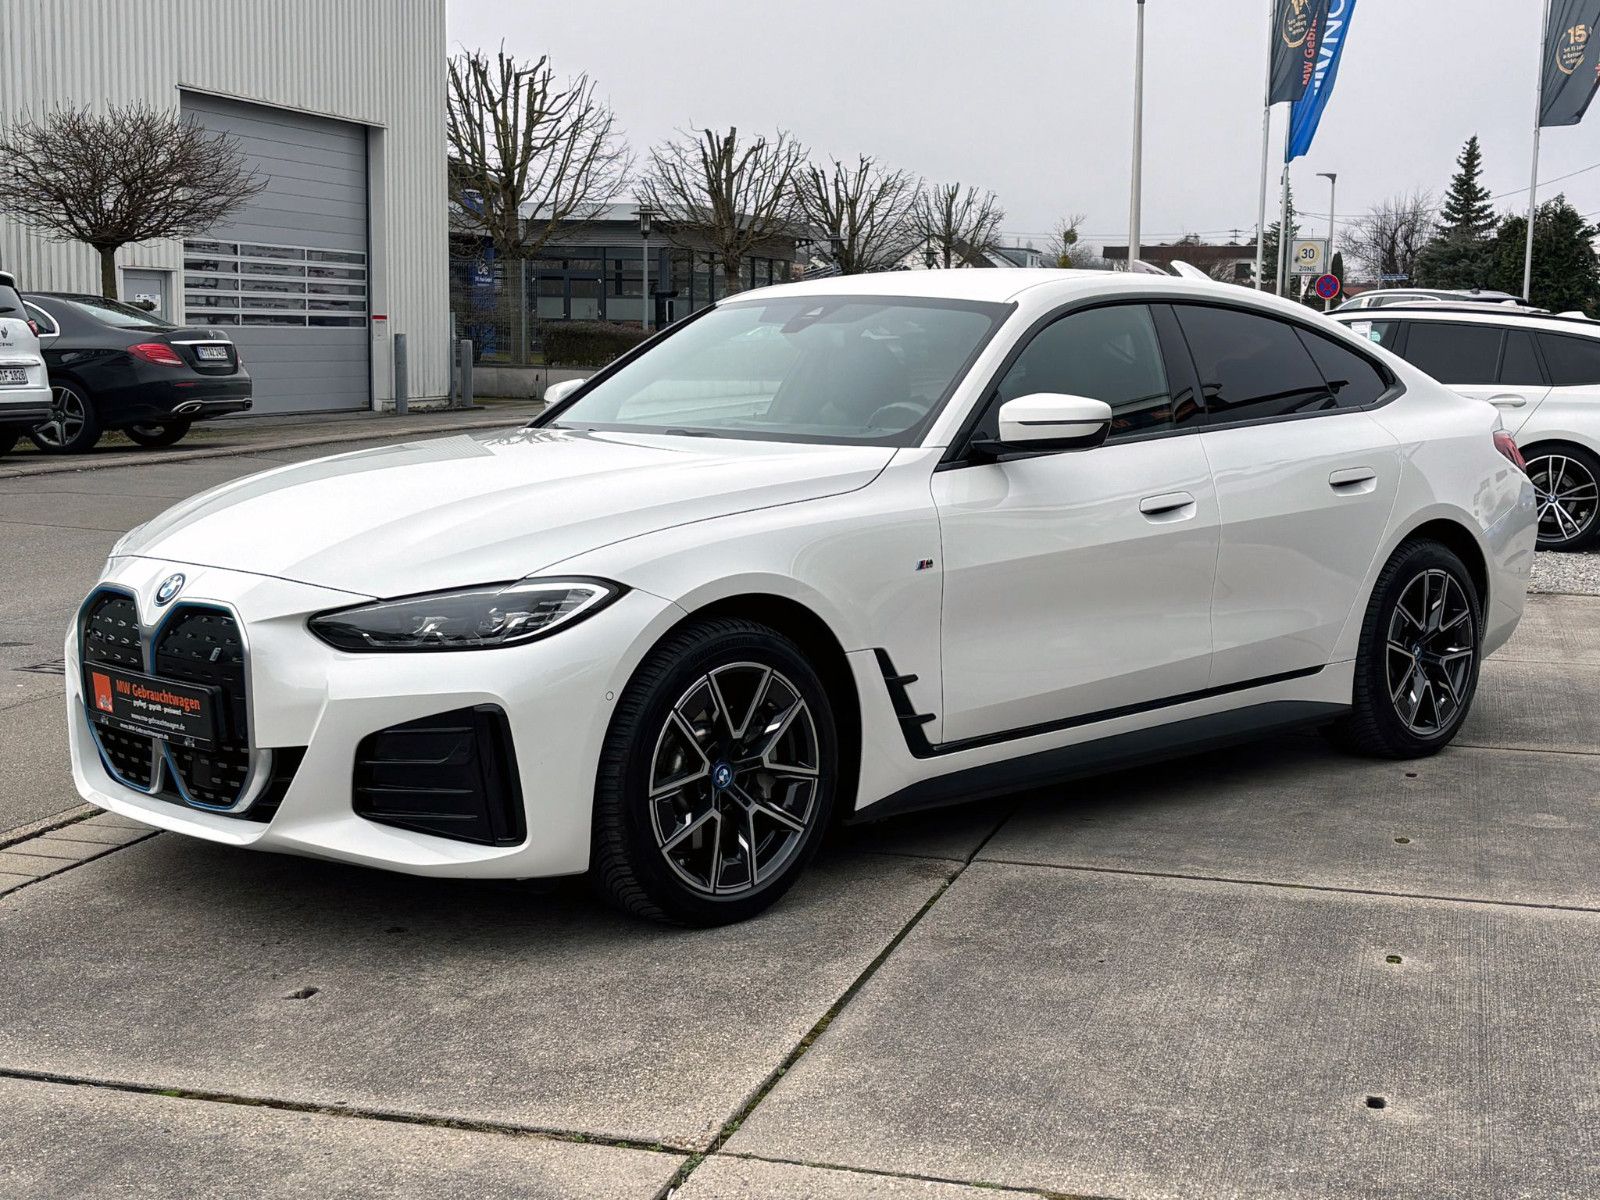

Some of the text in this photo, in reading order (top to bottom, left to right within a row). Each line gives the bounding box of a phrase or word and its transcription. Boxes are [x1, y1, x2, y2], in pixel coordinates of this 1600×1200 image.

[1567, 24, 1587, 44] 15
[1301, 248, 1315, 259] 30
[116, 680, 131, 694] MW
[132, 683, 201, 712] Gebrauchtwagen
